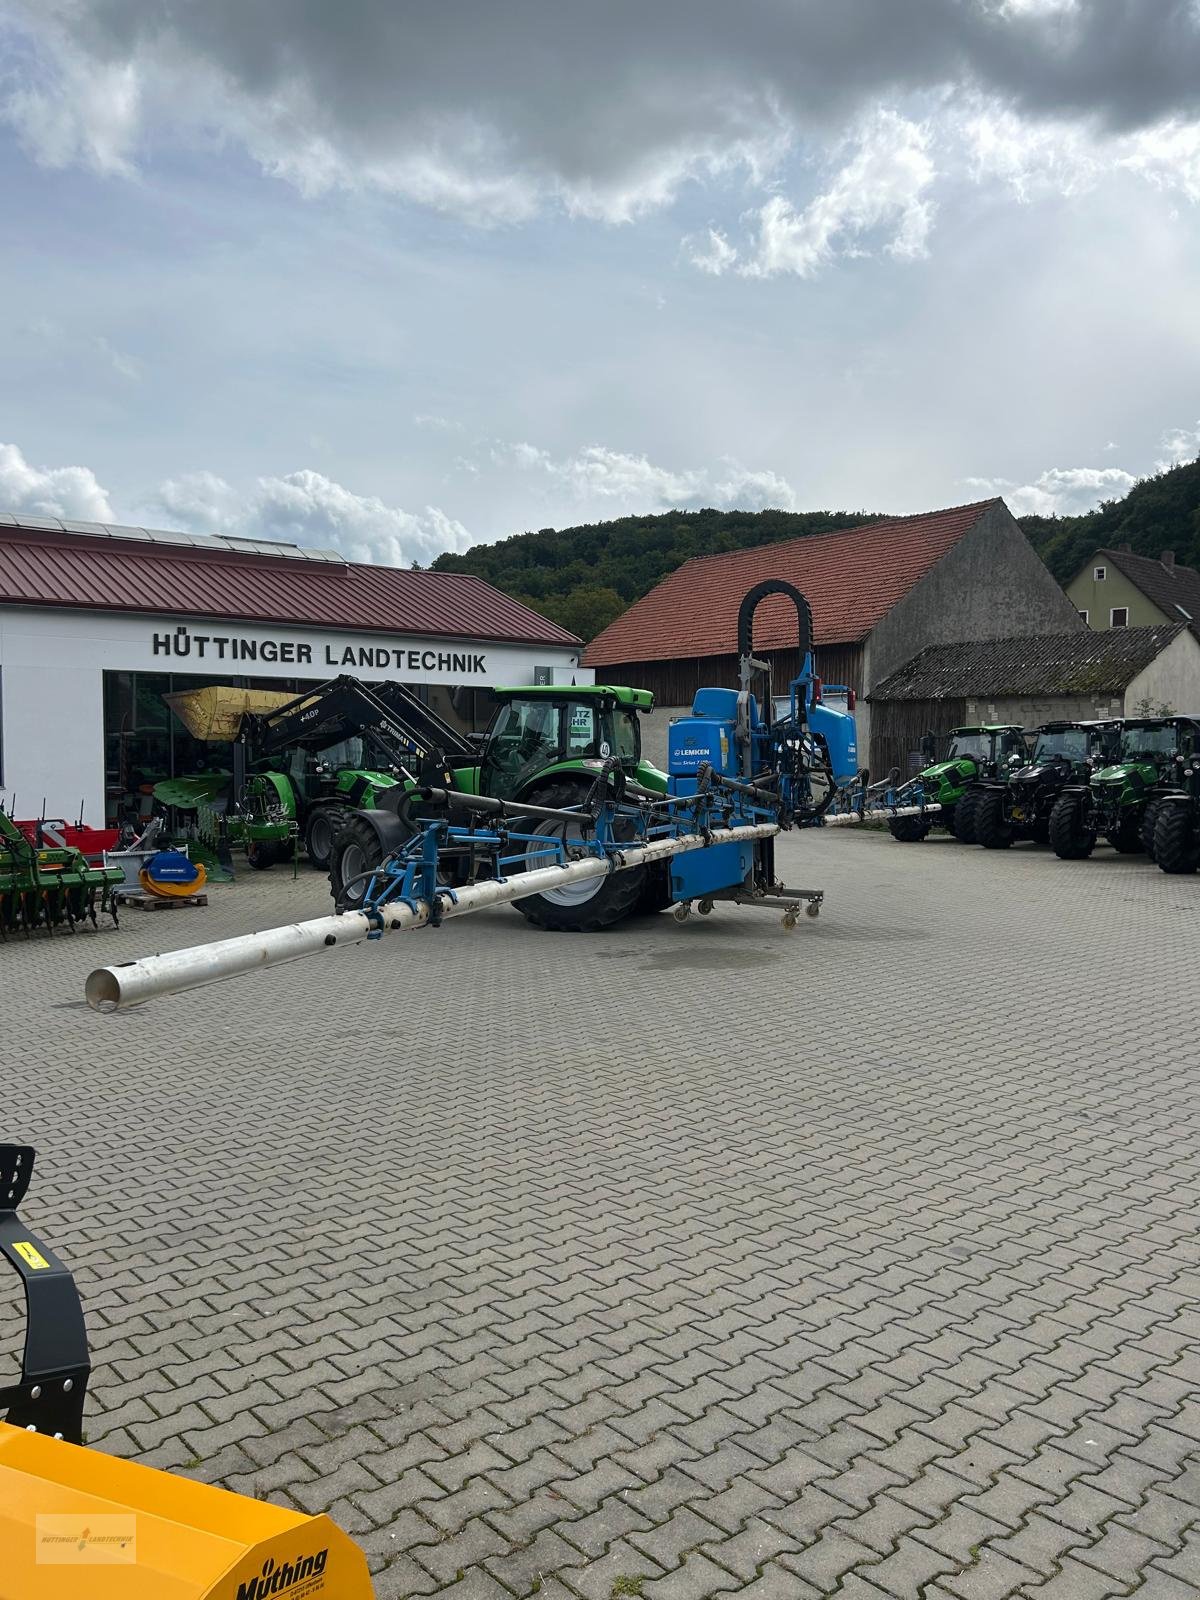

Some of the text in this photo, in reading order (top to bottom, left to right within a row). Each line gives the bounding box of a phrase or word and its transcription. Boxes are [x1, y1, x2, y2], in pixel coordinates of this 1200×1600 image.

[152, 626, 487, 673] HÜTTINGER LANDTECHNIK
[571, 718, 587, 726] HR
[386, 723, 404, 742] TRIMA
[602, 744, 609, 757] 40
[681, 748, 710, 756] LEMKEN
[236, 1548, 329, 1600] Müthing
